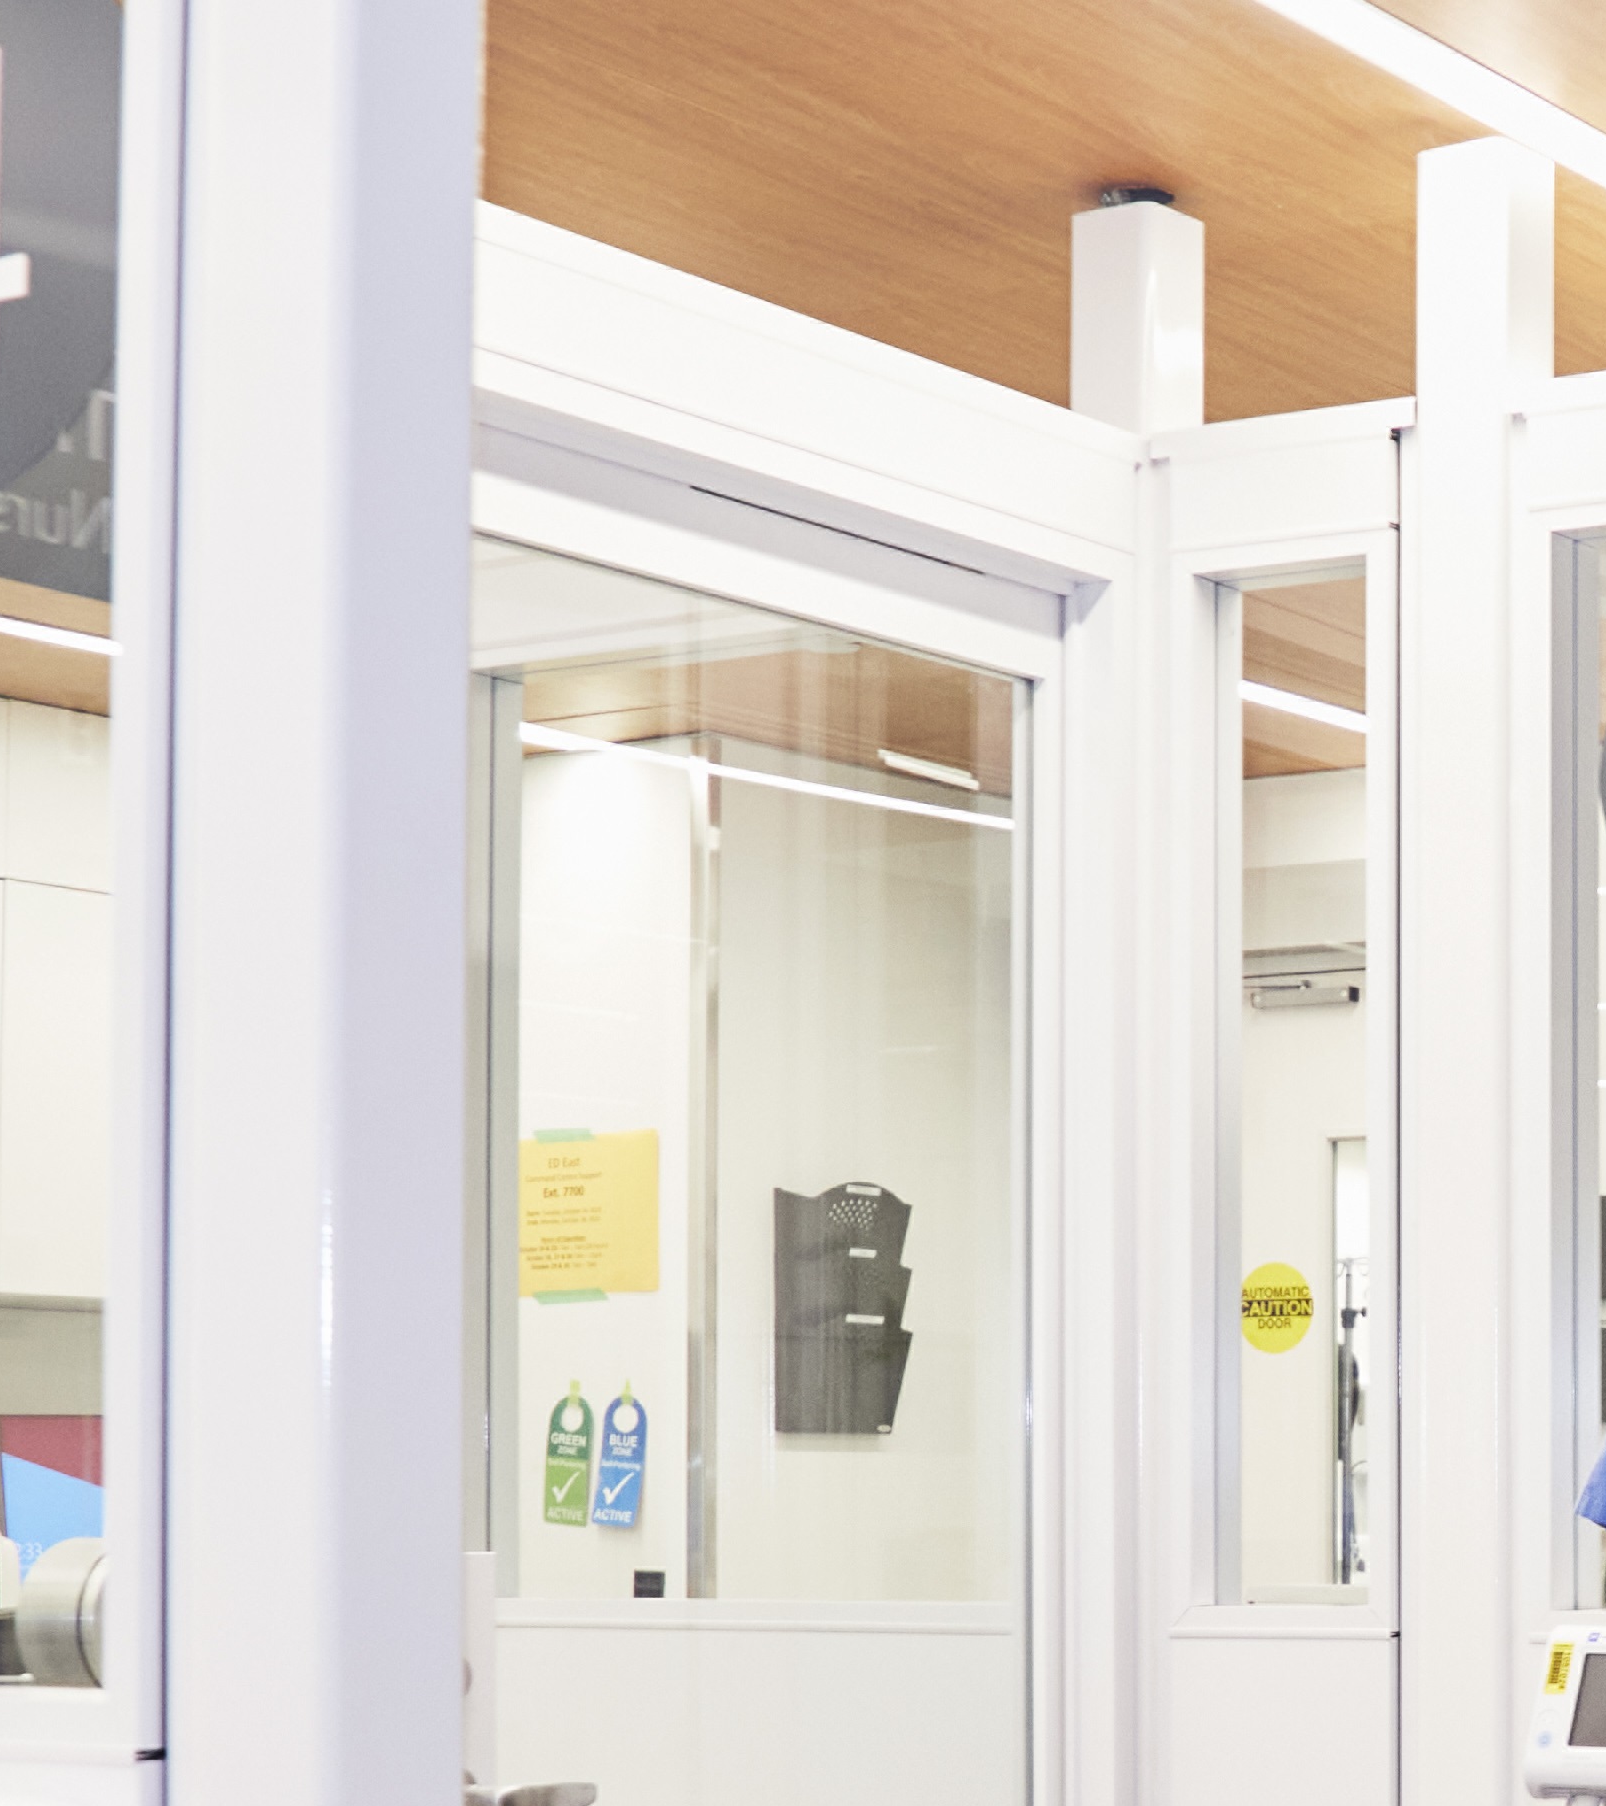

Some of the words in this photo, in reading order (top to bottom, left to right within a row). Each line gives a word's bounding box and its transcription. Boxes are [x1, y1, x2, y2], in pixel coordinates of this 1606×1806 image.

[1241, 1286, 1310, 1299] AUTOMATIC
[1241, 1300, 1313, 1317] CAUTION
[1257, 1317, 1292, 1329] DOOR
[550, 1433, 587, 1446] GREEN
[609, 1434, 638, 1447] BLUE
[547, 1506, 584, 1522] ACTIVE
[593, 1507, 634, 1524] ACTIVE
